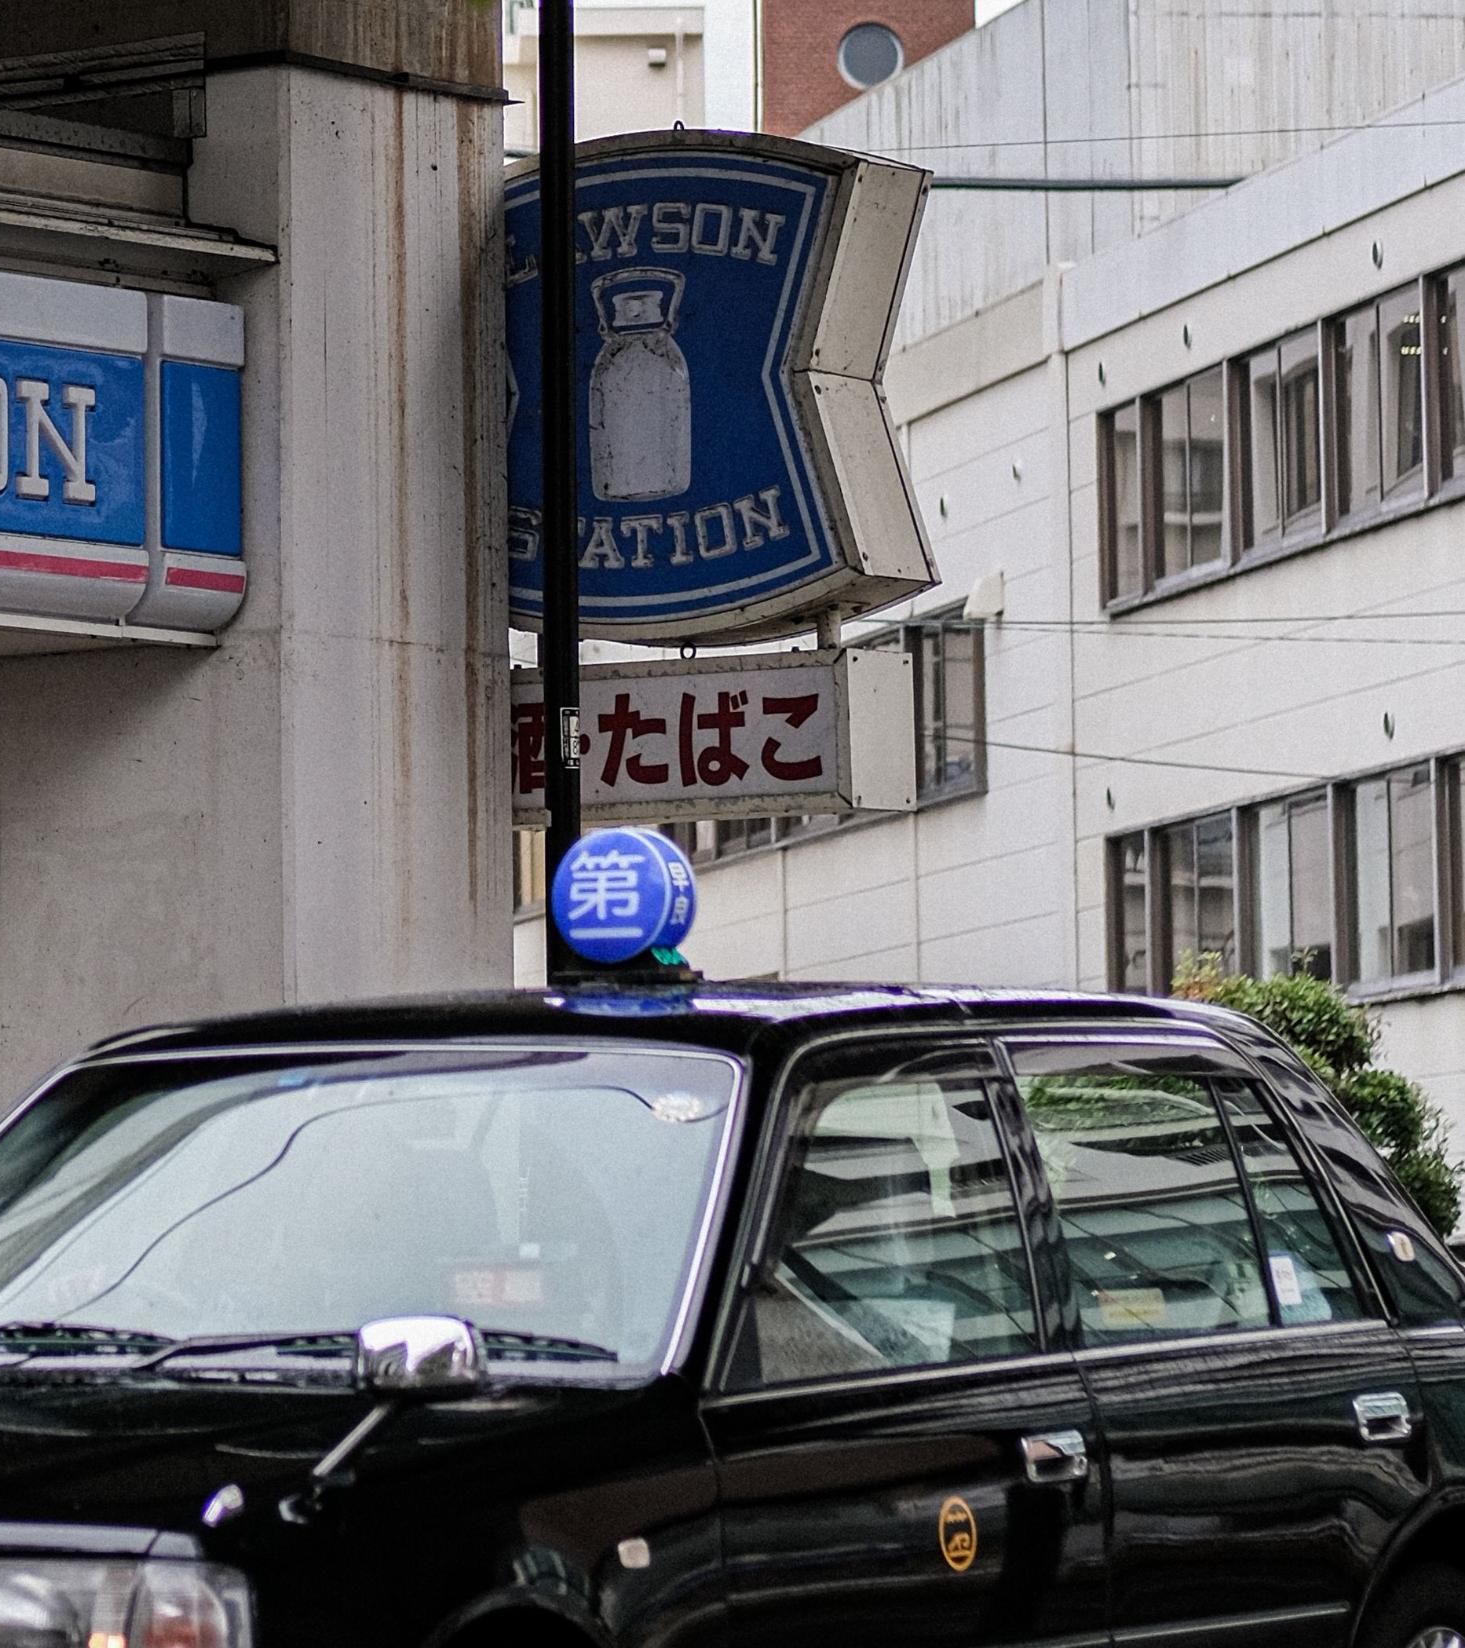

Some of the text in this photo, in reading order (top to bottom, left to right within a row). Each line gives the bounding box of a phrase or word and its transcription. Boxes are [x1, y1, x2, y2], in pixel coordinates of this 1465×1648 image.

[506, 203, 785, 286] LWSON
[508, 486, 789, 569] SATION
[568, 849, 646, 940] 第一
